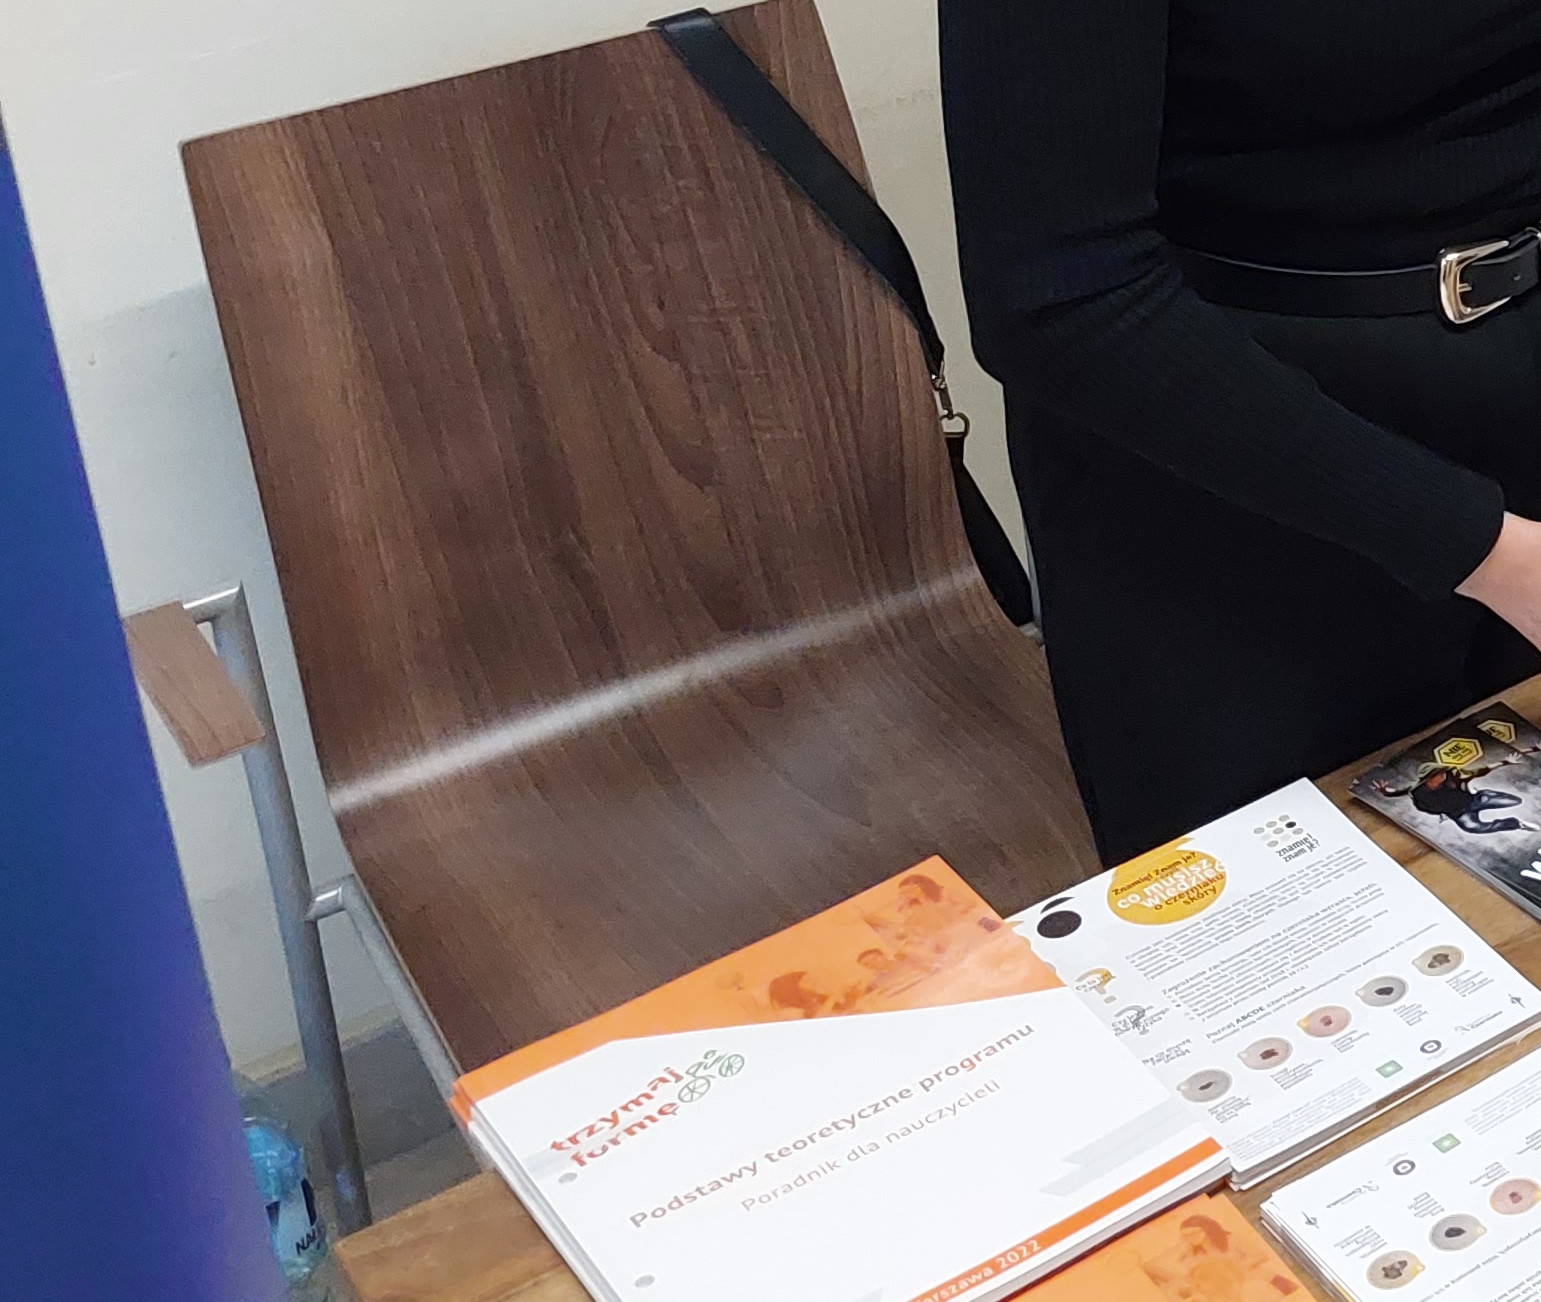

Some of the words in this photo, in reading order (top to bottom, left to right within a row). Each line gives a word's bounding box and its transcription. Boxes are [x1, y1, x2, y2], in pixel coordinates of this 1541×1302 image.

[1275, 832, 1313, 857] znamię!
[1282, 848, 1307, 863] znam
[1305, 838, 1321, 853] je?
[1112, 873, 1153, 896] Znamię!
[1154, 860, 1182, 876] Znam
[1182, 852, 1197, 863] je?
[1117, 893, 1141, 908] co
[1143, 859, 1209, 896] musisz
[1141, 860, 1226, 908] wiedzieć
[1164, 873, 1225, 906] czerniaku
[1182, 886, 1217, 906] skóry
[1235, 1005, 1265, 1025] ABCDE
[550, 1066, 684, 1152] trzymaj
[629, 1161, 758, 1228] Podstawy
[764, 1085, 912, 1164] teoretyczne
[919, 1023, 1034, 1093] programu
[570, 1101, 678, 1168] formę
[741, 1159, 842, 1212] Poradnik
[846, 1140, 881, 1164] dla
[885, 1079, 1001, 1145] nauczycieli
[917, 1264, 994, 1301] arszawa
[996, 1239, 1042, 1270] 2022
